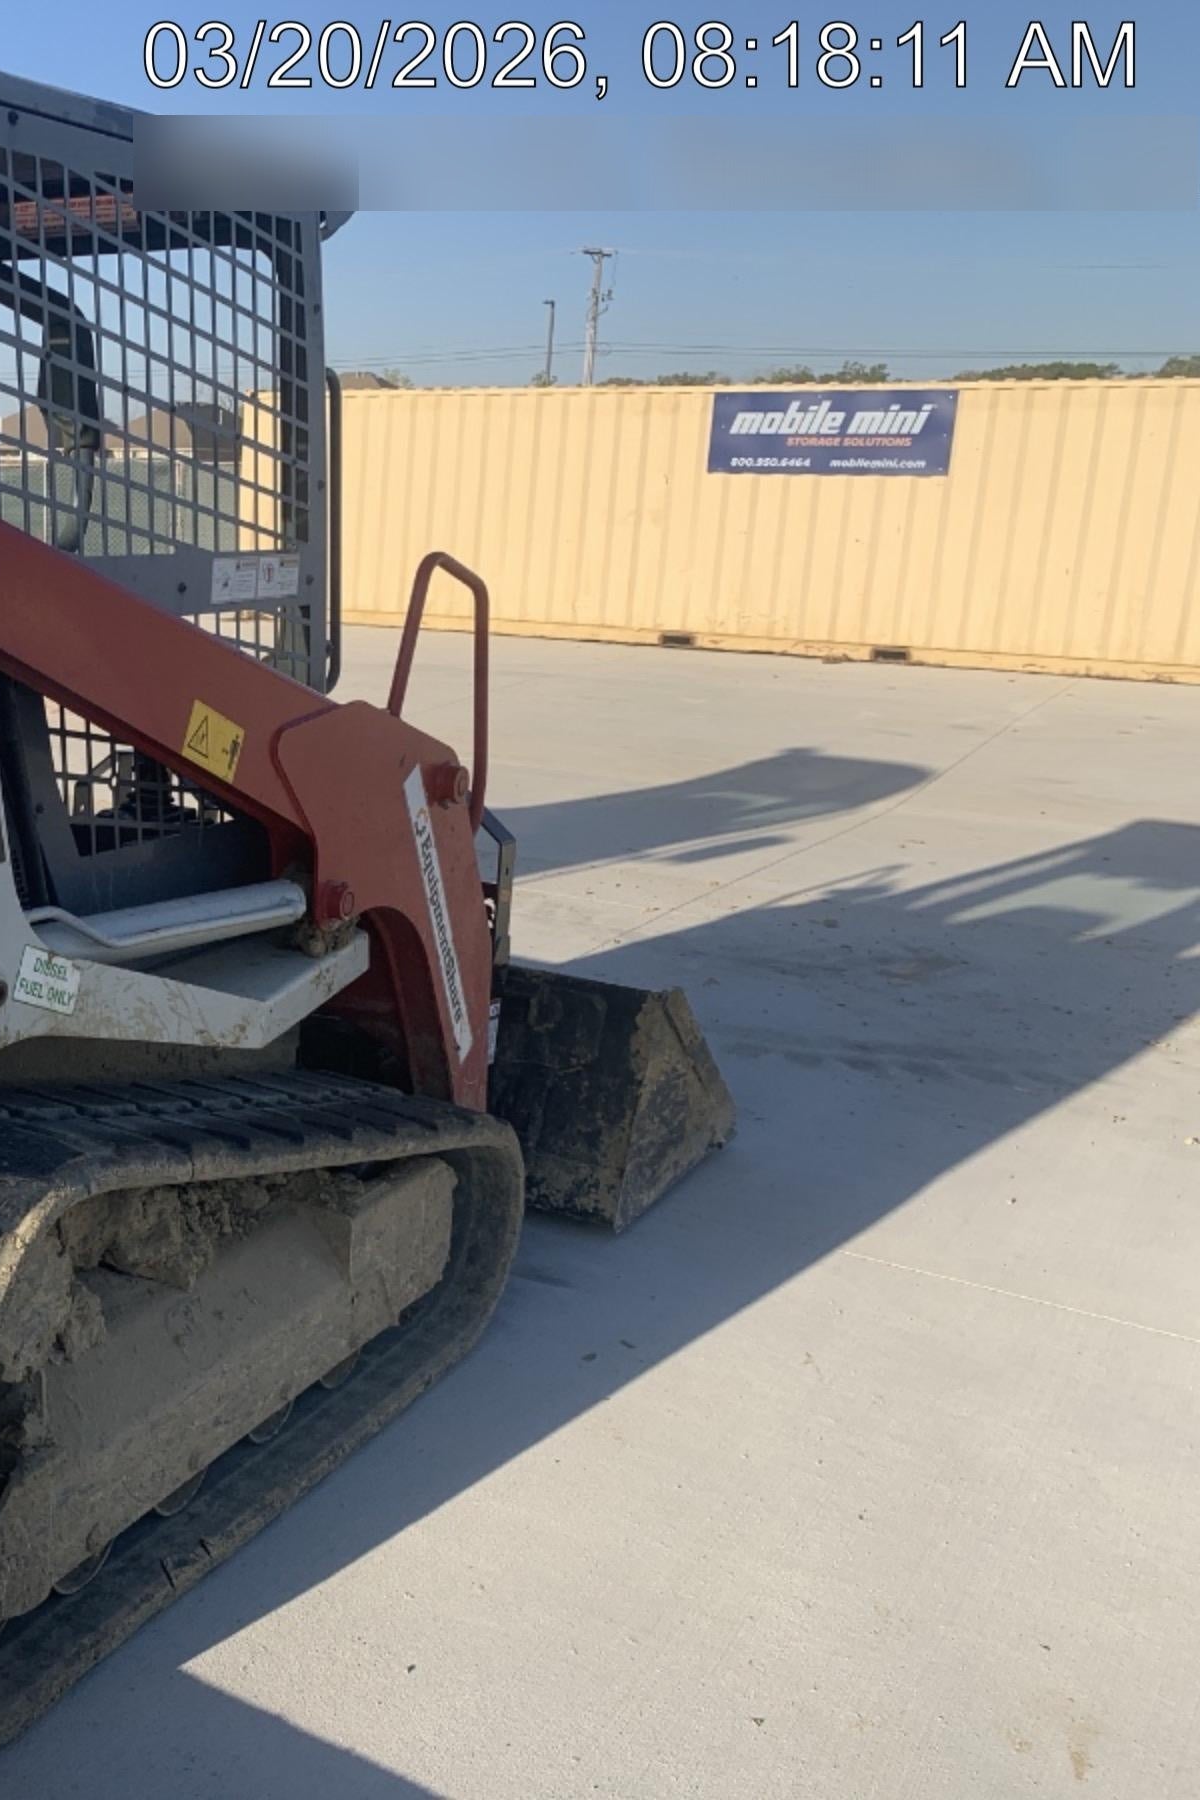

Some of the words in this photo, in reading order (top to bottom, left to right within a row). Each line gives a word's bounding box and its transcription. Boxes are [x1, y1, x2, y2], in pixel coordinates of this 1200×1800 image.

[729, 400, 846, 435] mobile
[846, 403, 932, 435] mini
[786, 436, 841, 447] STORAGE
[843, 436, 912, 447] SOLUTIONS
